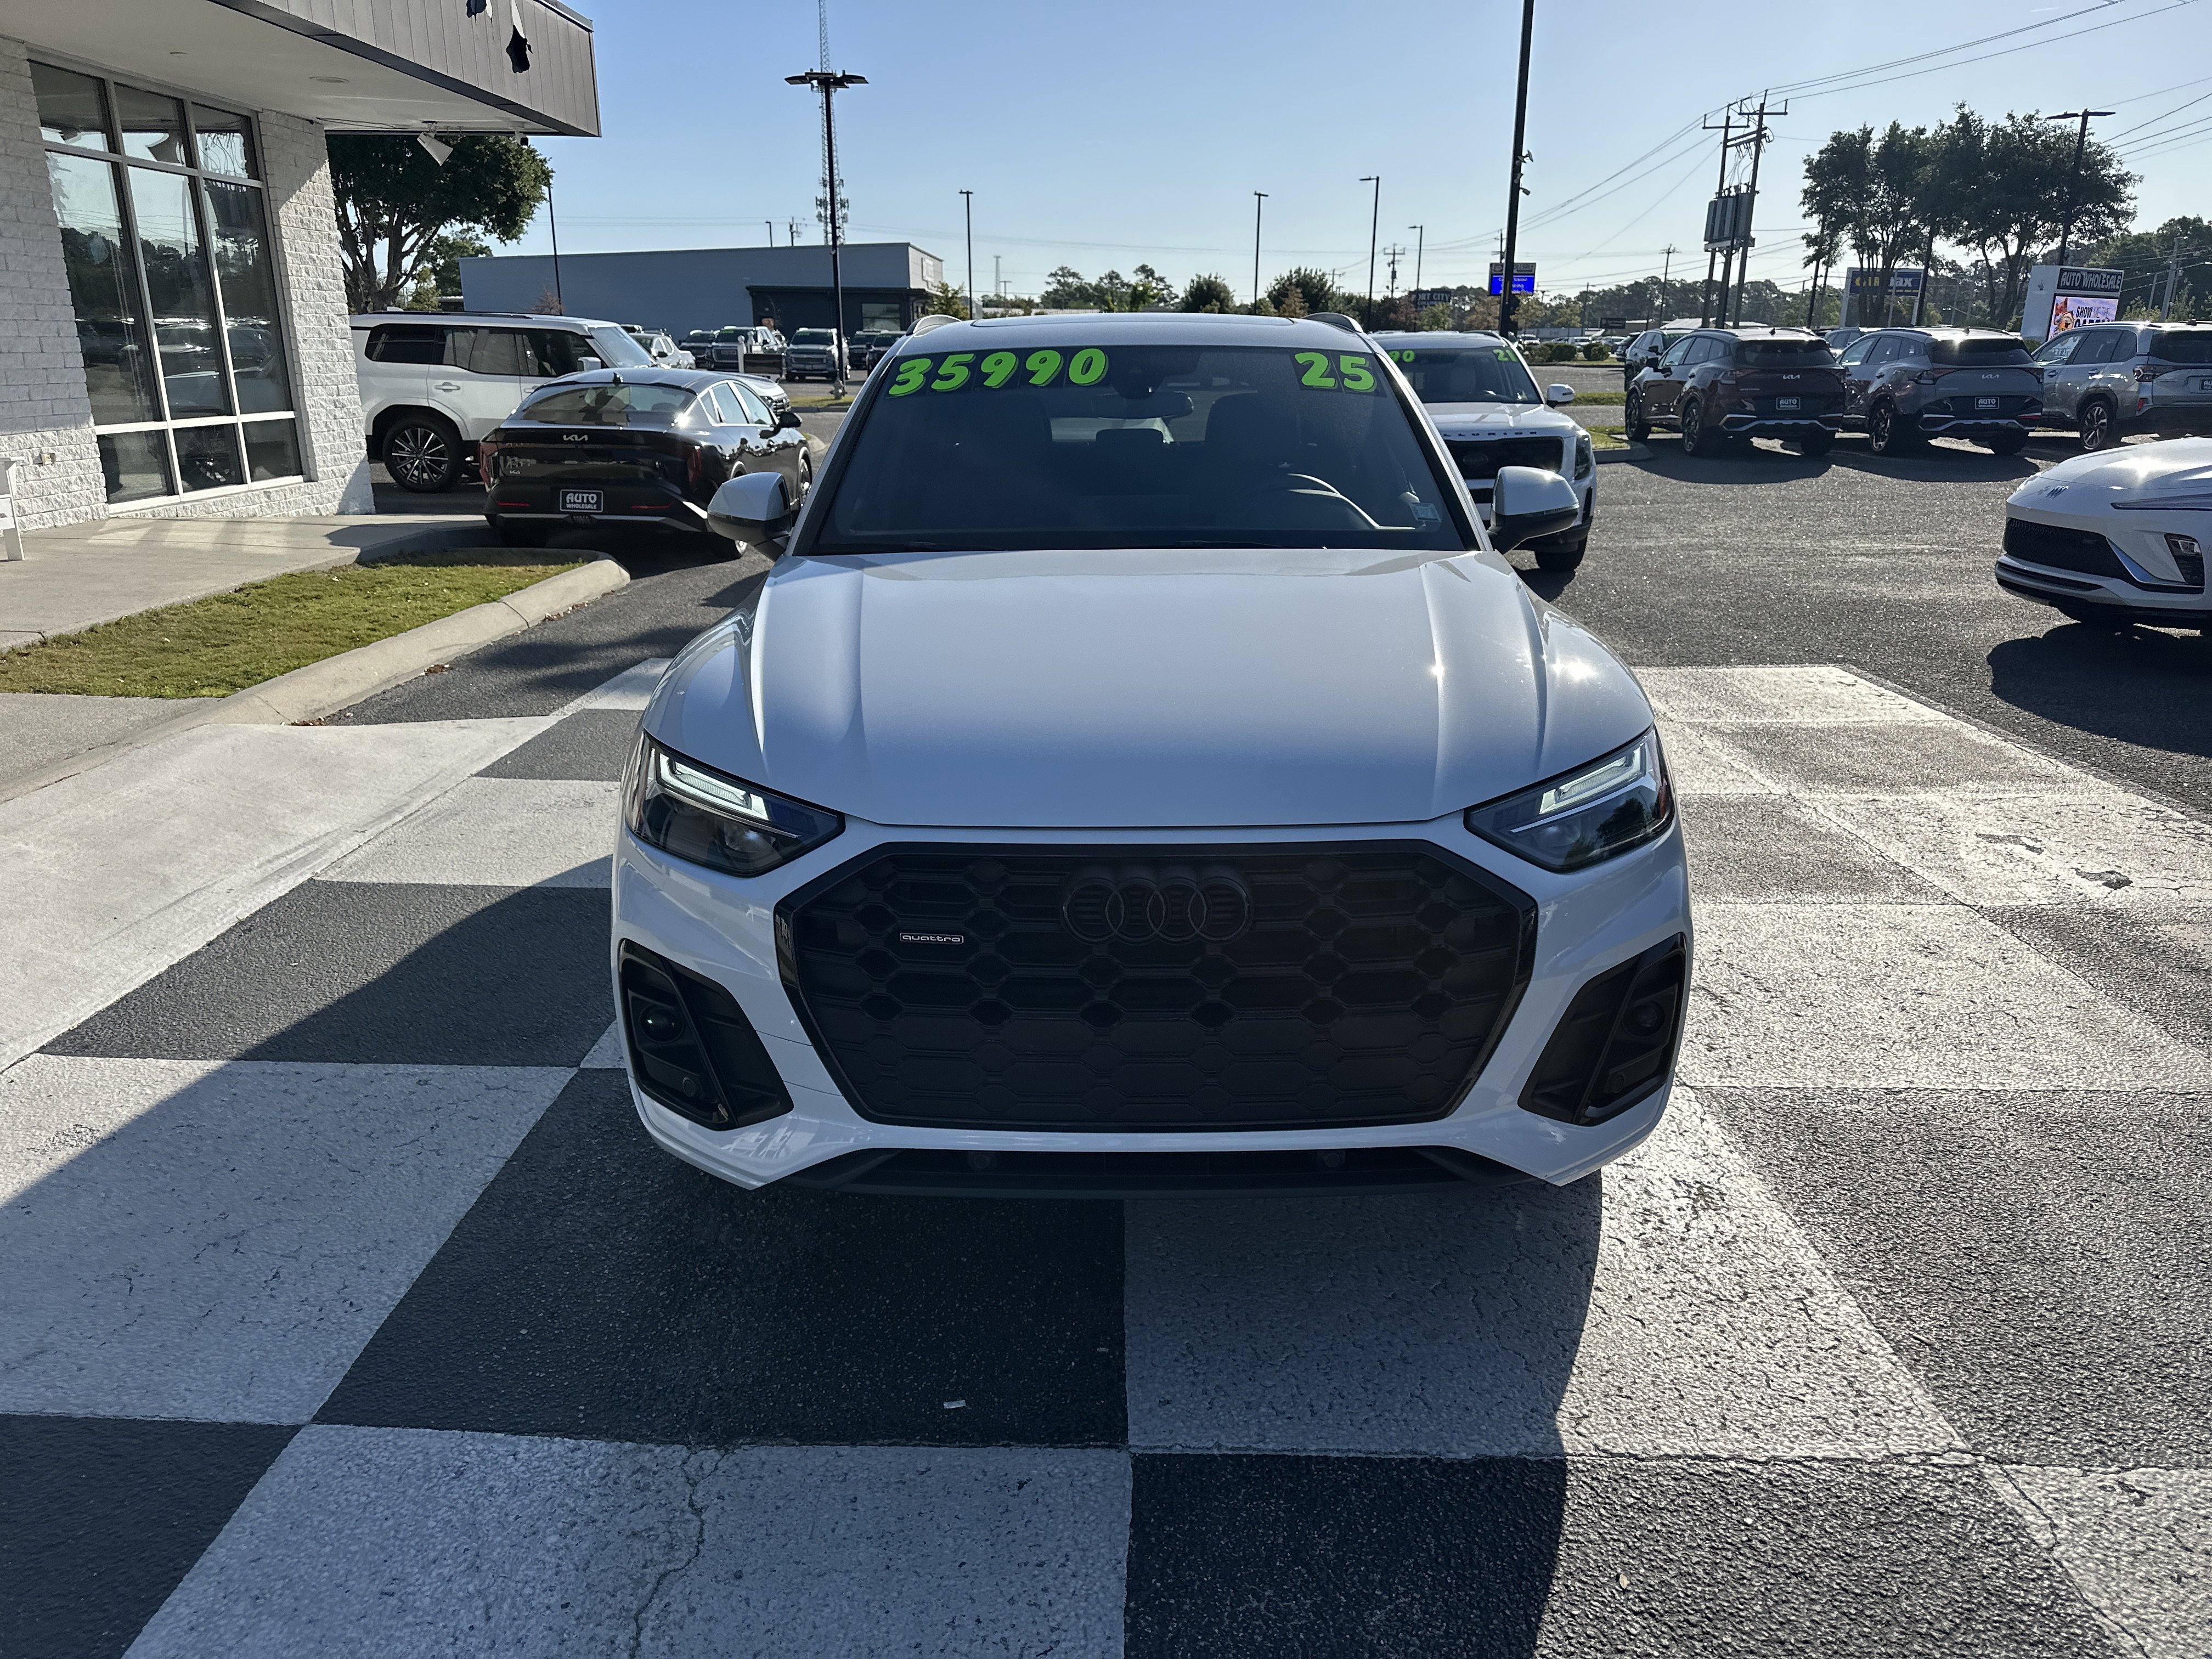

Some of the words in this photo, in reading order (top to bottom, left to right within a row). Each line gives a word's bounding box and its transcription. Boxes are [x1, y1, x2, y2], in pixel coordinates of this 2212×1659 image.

[2061, 272, 2081, 286] AUTO
[2082, 273, 2121, 290] WHOLESALE
[1433, 292, 1450, 301] CITY
[2076, 306, 2093, 318] SHOW
[1389, 350, 1415, 363] 90
[1492, 349, 1519, 362] 21
[888, 348, 1108, 397] 35990
[1294, 352, 1378, 393] 25
[566, 493, 597, 503] AUTO
